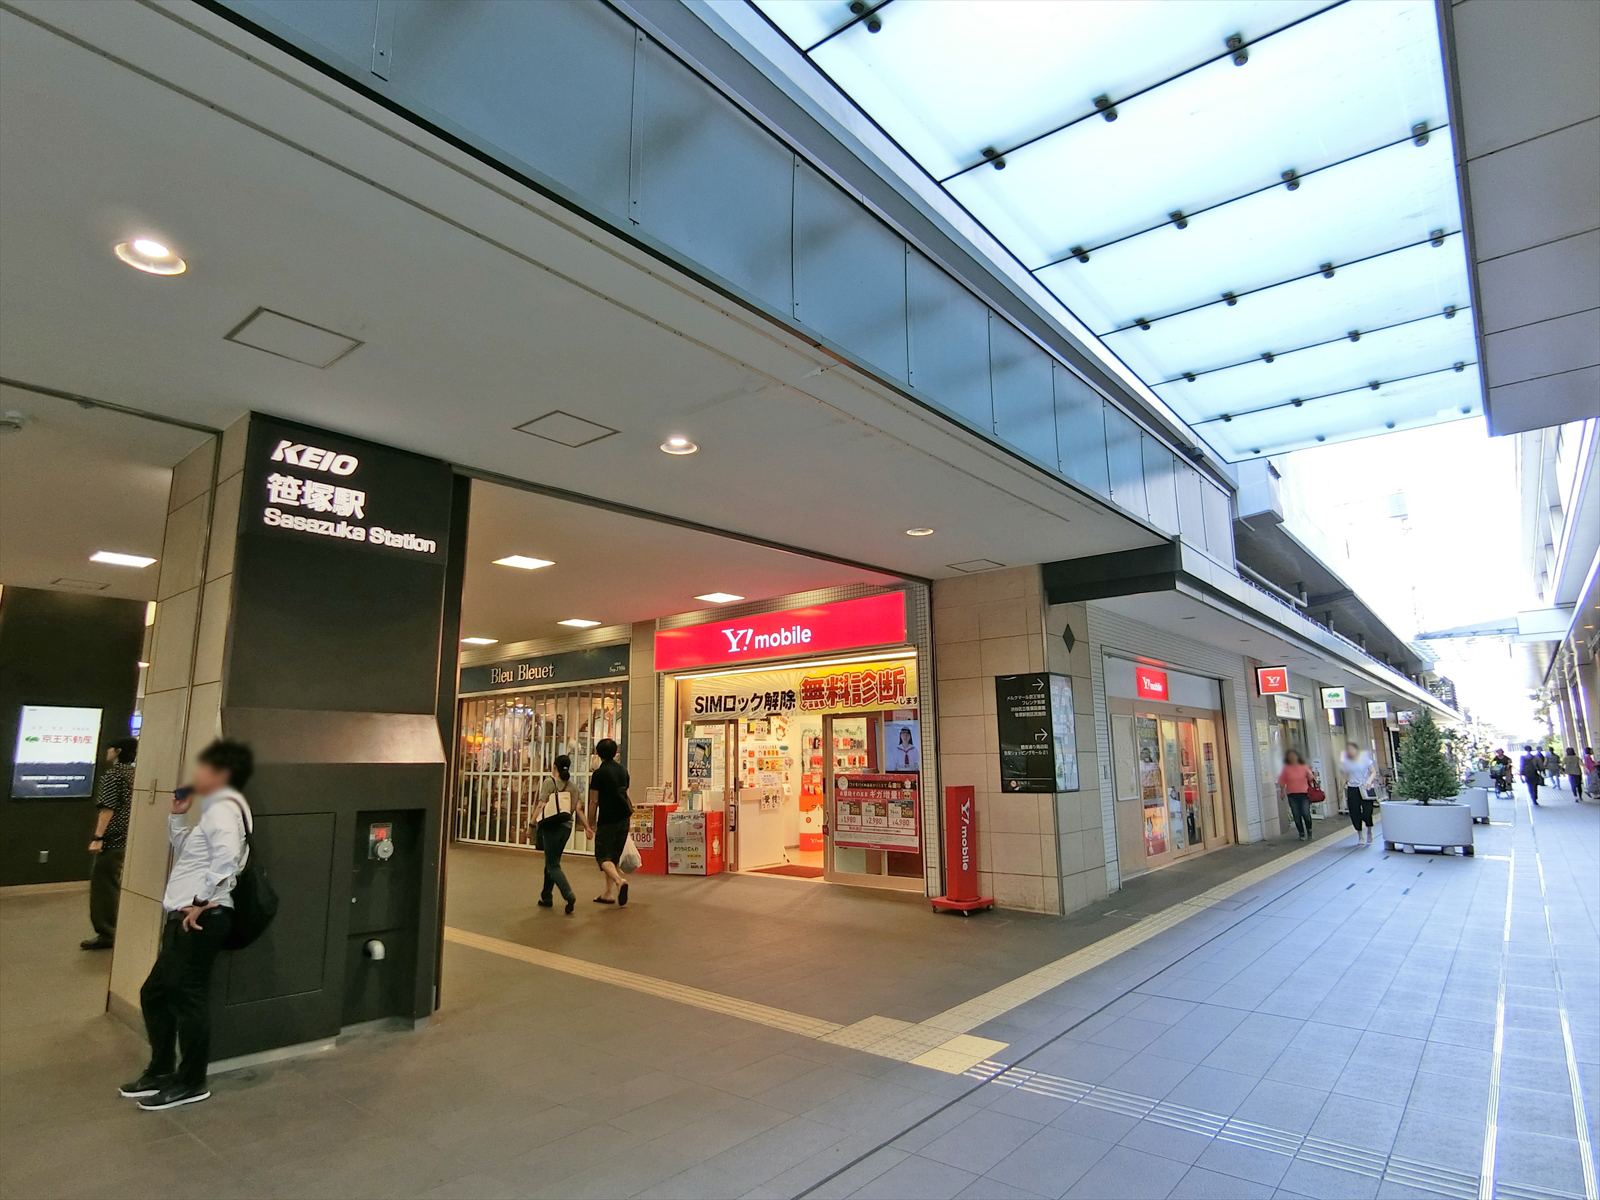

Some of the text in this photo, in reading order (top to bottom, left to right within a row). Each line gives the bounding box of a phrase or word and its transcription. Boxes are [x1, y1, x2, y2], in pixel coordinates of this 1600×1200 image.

[271, 440, 358, 476] KEIO
[266, 472, 366, 519] 笹塚駅
[263, 507, 436, 554] Sasazuka Station
[490, 662, 555, 684] Bleu Bleuet
[694, 689, 797, 714] SIMロック解除
[800, 665, 907, 711] 無料診断
[41, 734, 93, 744] 京王不動産
[688, 760, 711, 769] かんたん
[691, 768, 708, 777] スマホ
[961, 797, 970, 871] Y!mobile
